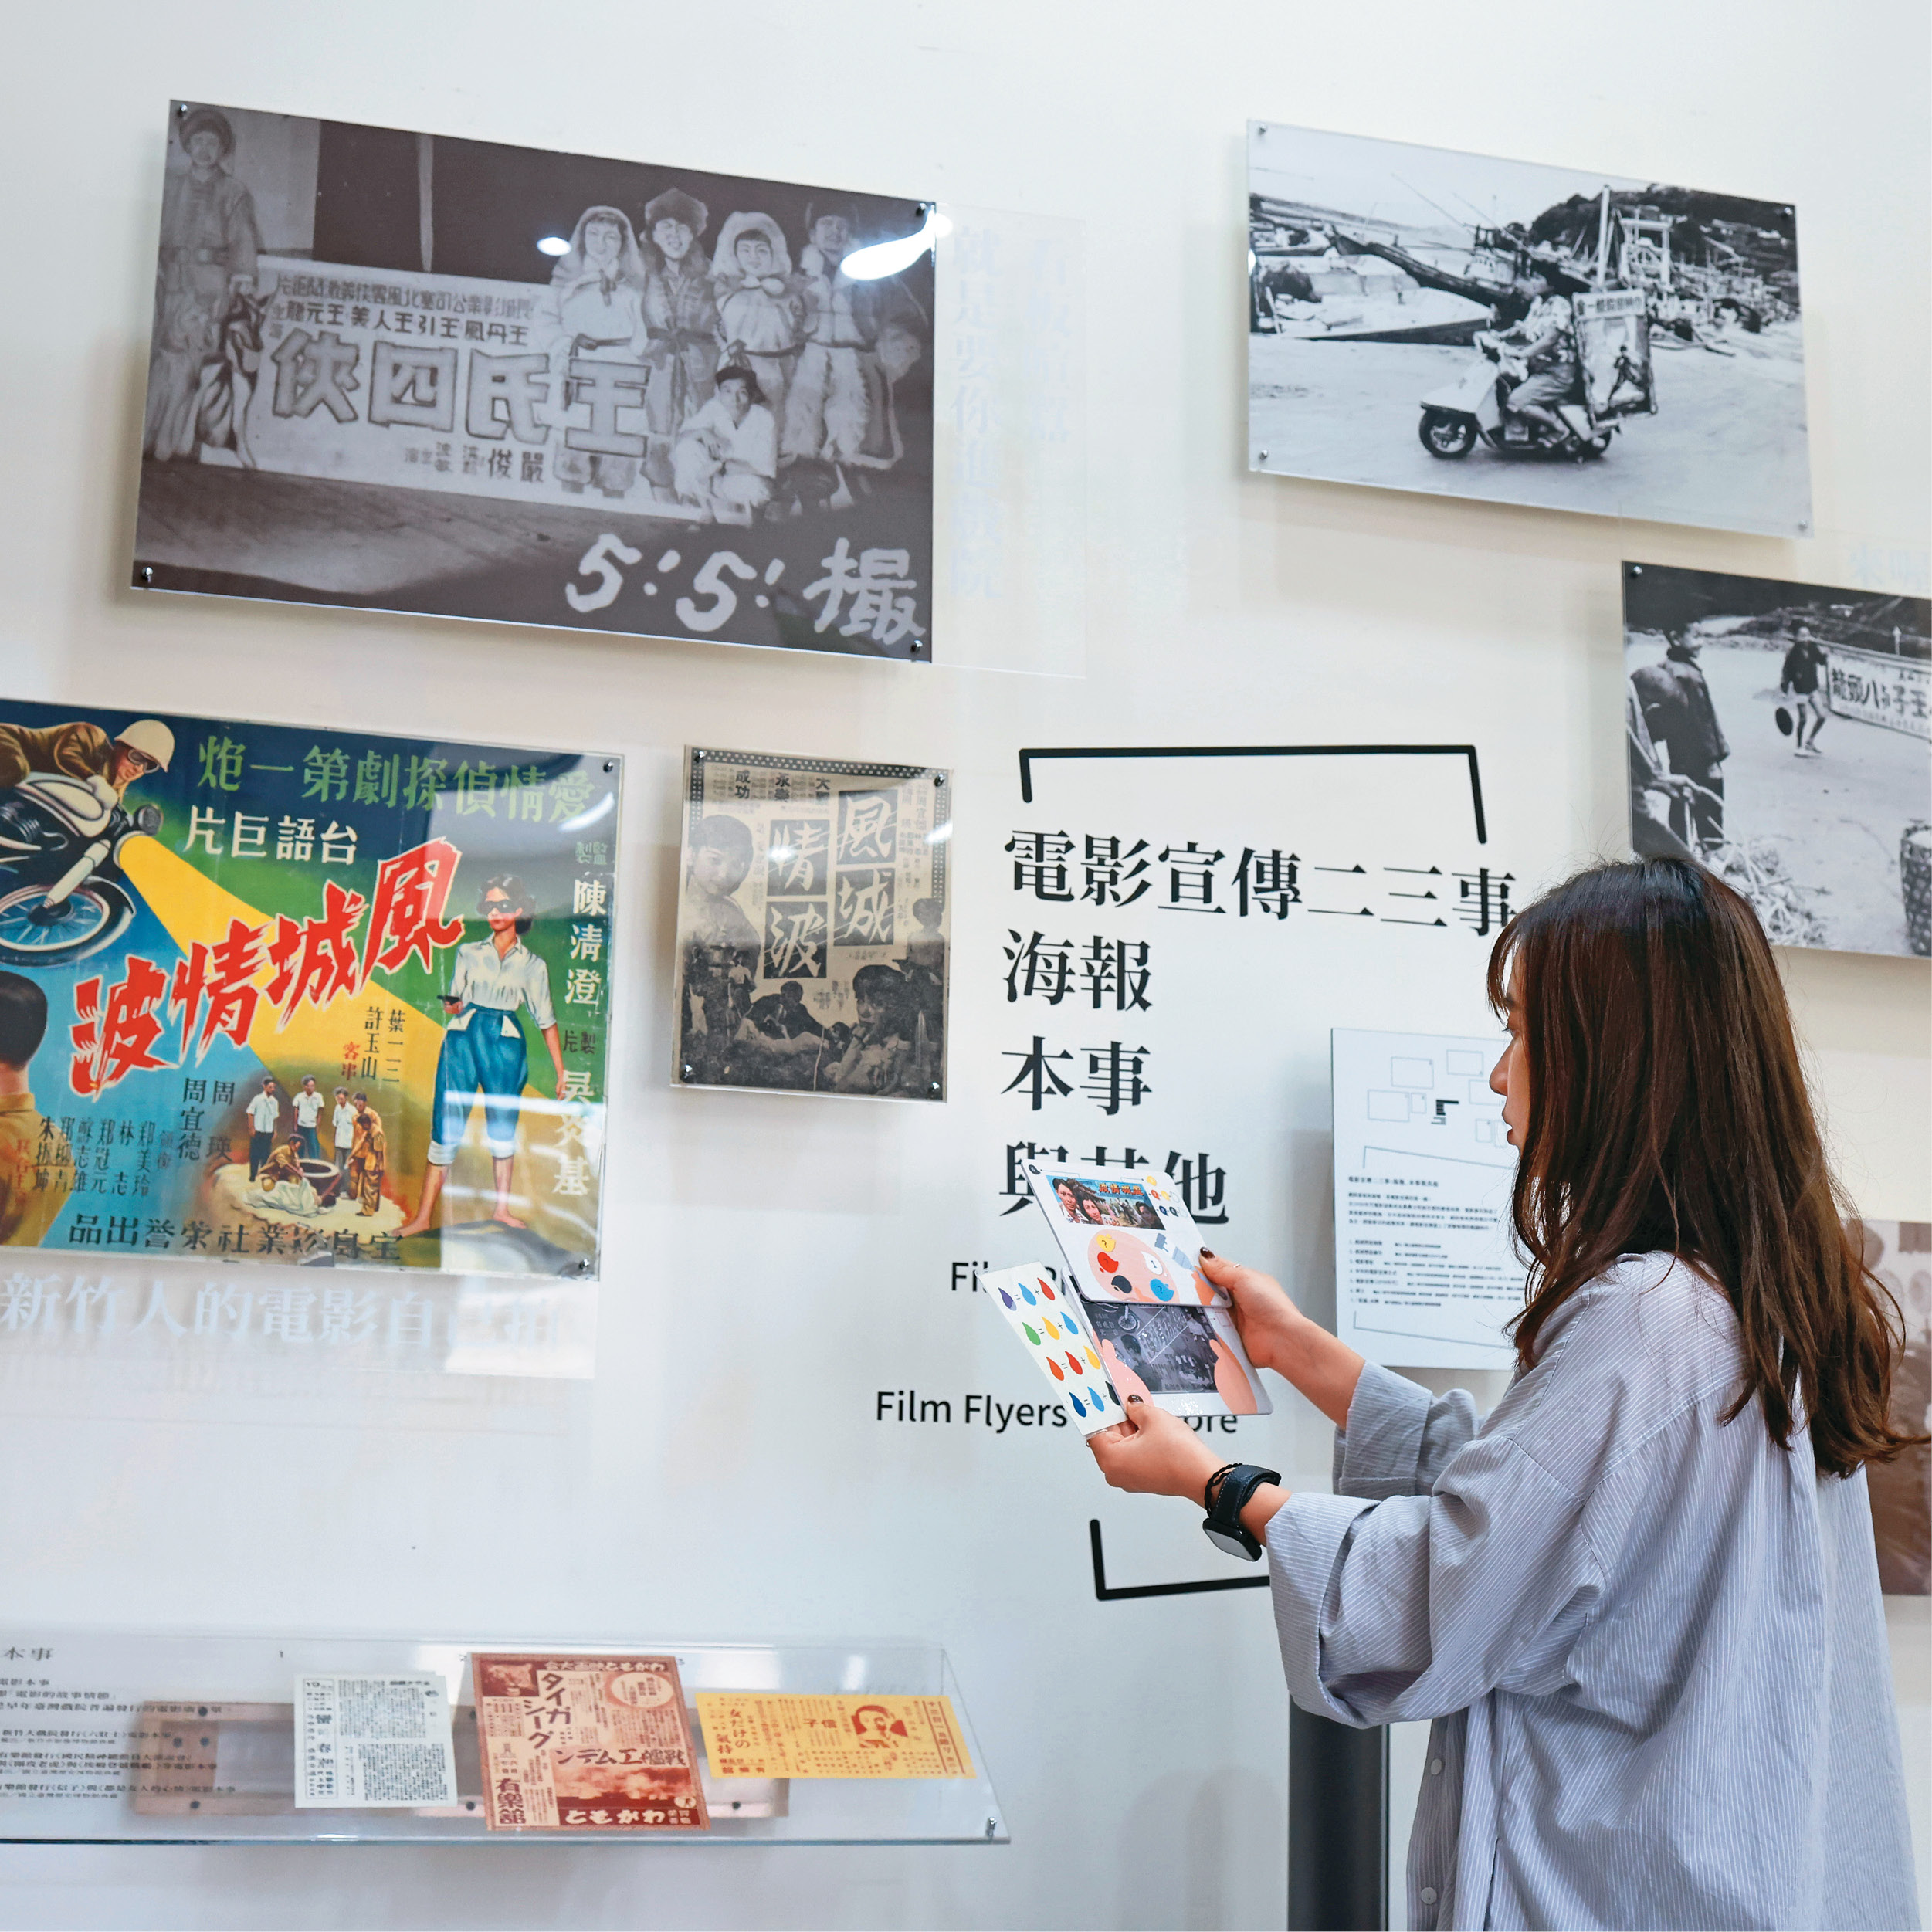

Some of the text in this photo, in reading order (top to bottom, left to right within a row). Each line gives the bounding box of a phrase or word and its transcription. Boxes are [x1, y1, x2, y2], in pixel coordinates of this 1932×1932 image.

[1002, 829, 1517, 936] 電影宣傳二三事
[1002, 929, 1153, 1012] 海報
[361, 1006, 385, 1080] 許玉山
[1001, 1035, 1153, 1115] 本事
[876, 1390, 951, 1423] Film
[964, 1394, 1067, 1435] Flyers
